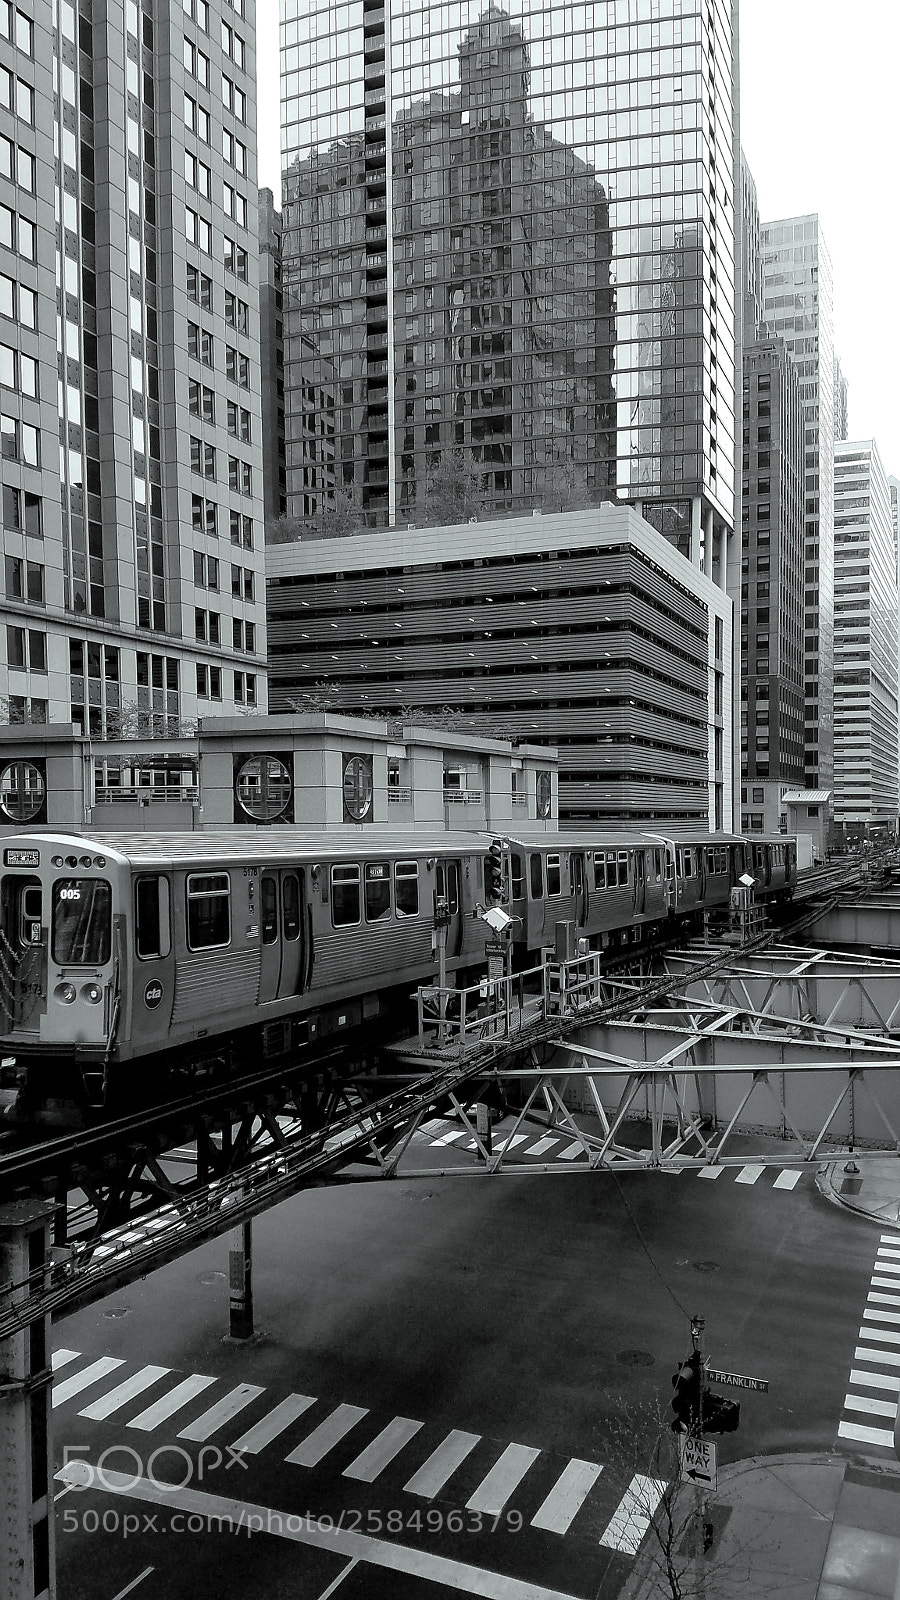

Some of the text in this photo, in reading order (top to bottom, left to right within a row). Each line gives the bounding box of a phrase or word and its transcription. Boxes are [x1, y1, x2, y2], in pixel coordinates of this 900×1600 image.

[60, 889, 81, 900] 005
[146, 988, 161, 1000] cta
[715, 1373, 757, 1390] FRANKLIN
[686, 1440, 710, 1456] ONE
[685, 1452, 711, 1468] WAY
